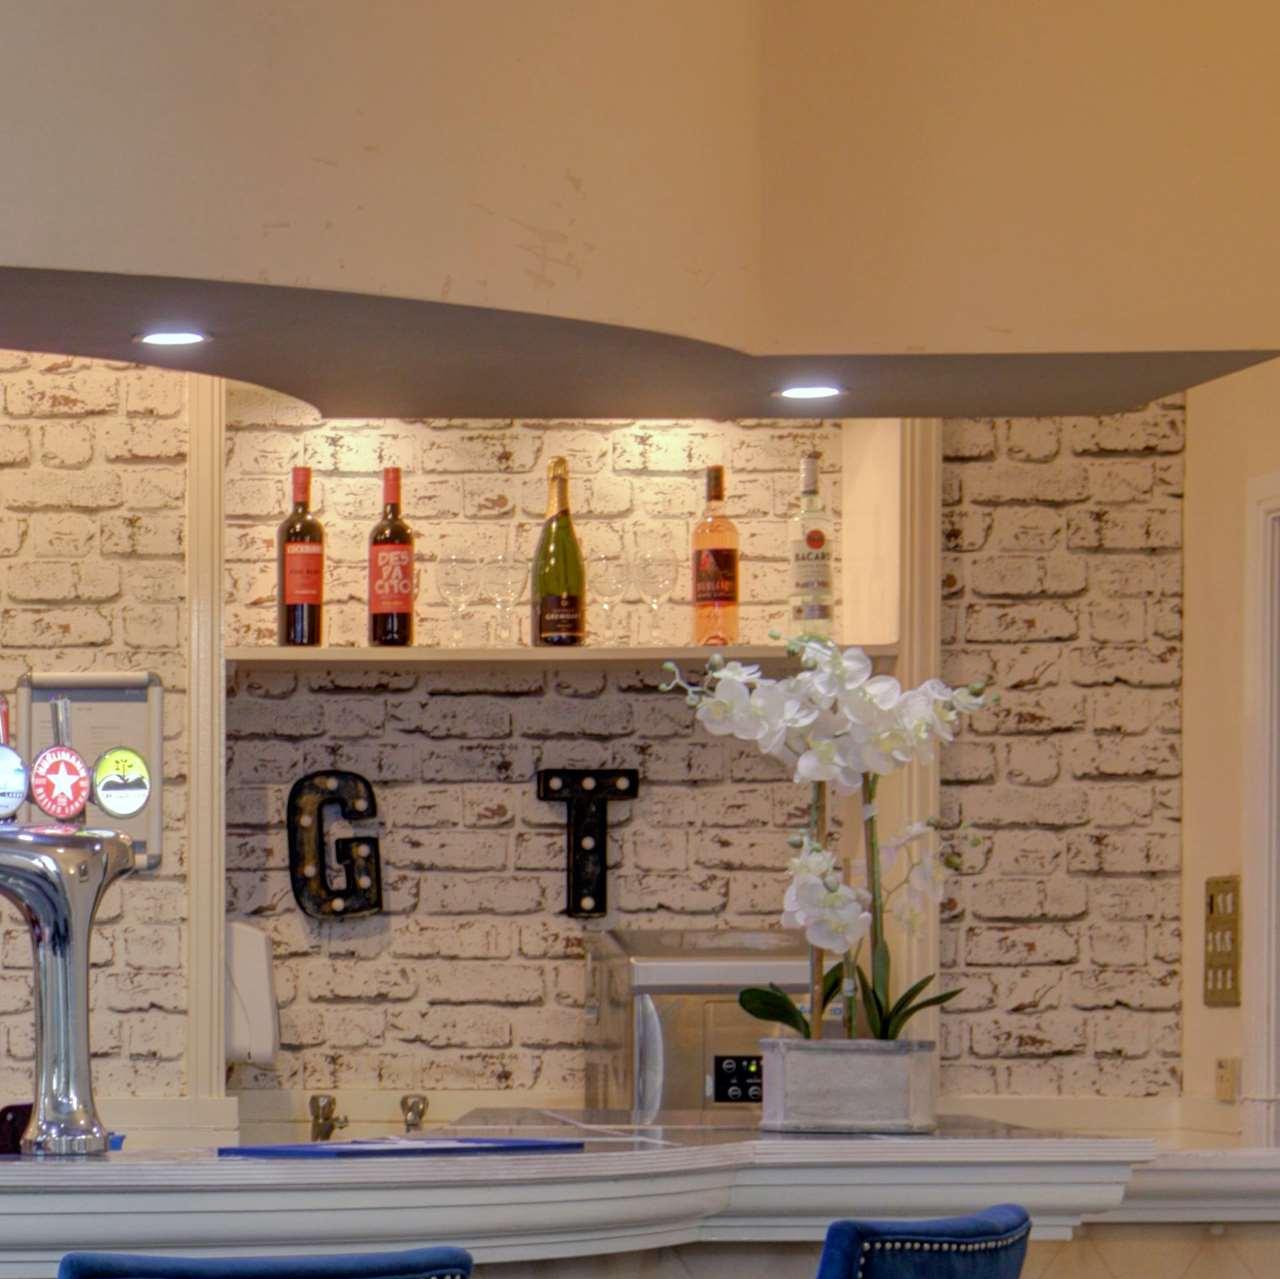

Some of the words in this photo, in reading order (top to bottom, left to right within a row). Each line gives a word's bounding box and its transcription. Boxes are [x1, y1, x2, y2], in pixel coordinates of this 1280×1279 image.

[377, 551, 409, 567] DES
[382, 566, 403, 580] PA
[375, 581, 411, 595] CITO
[286, 770, 383, 919] G
[537, 769, 639, 918] T
